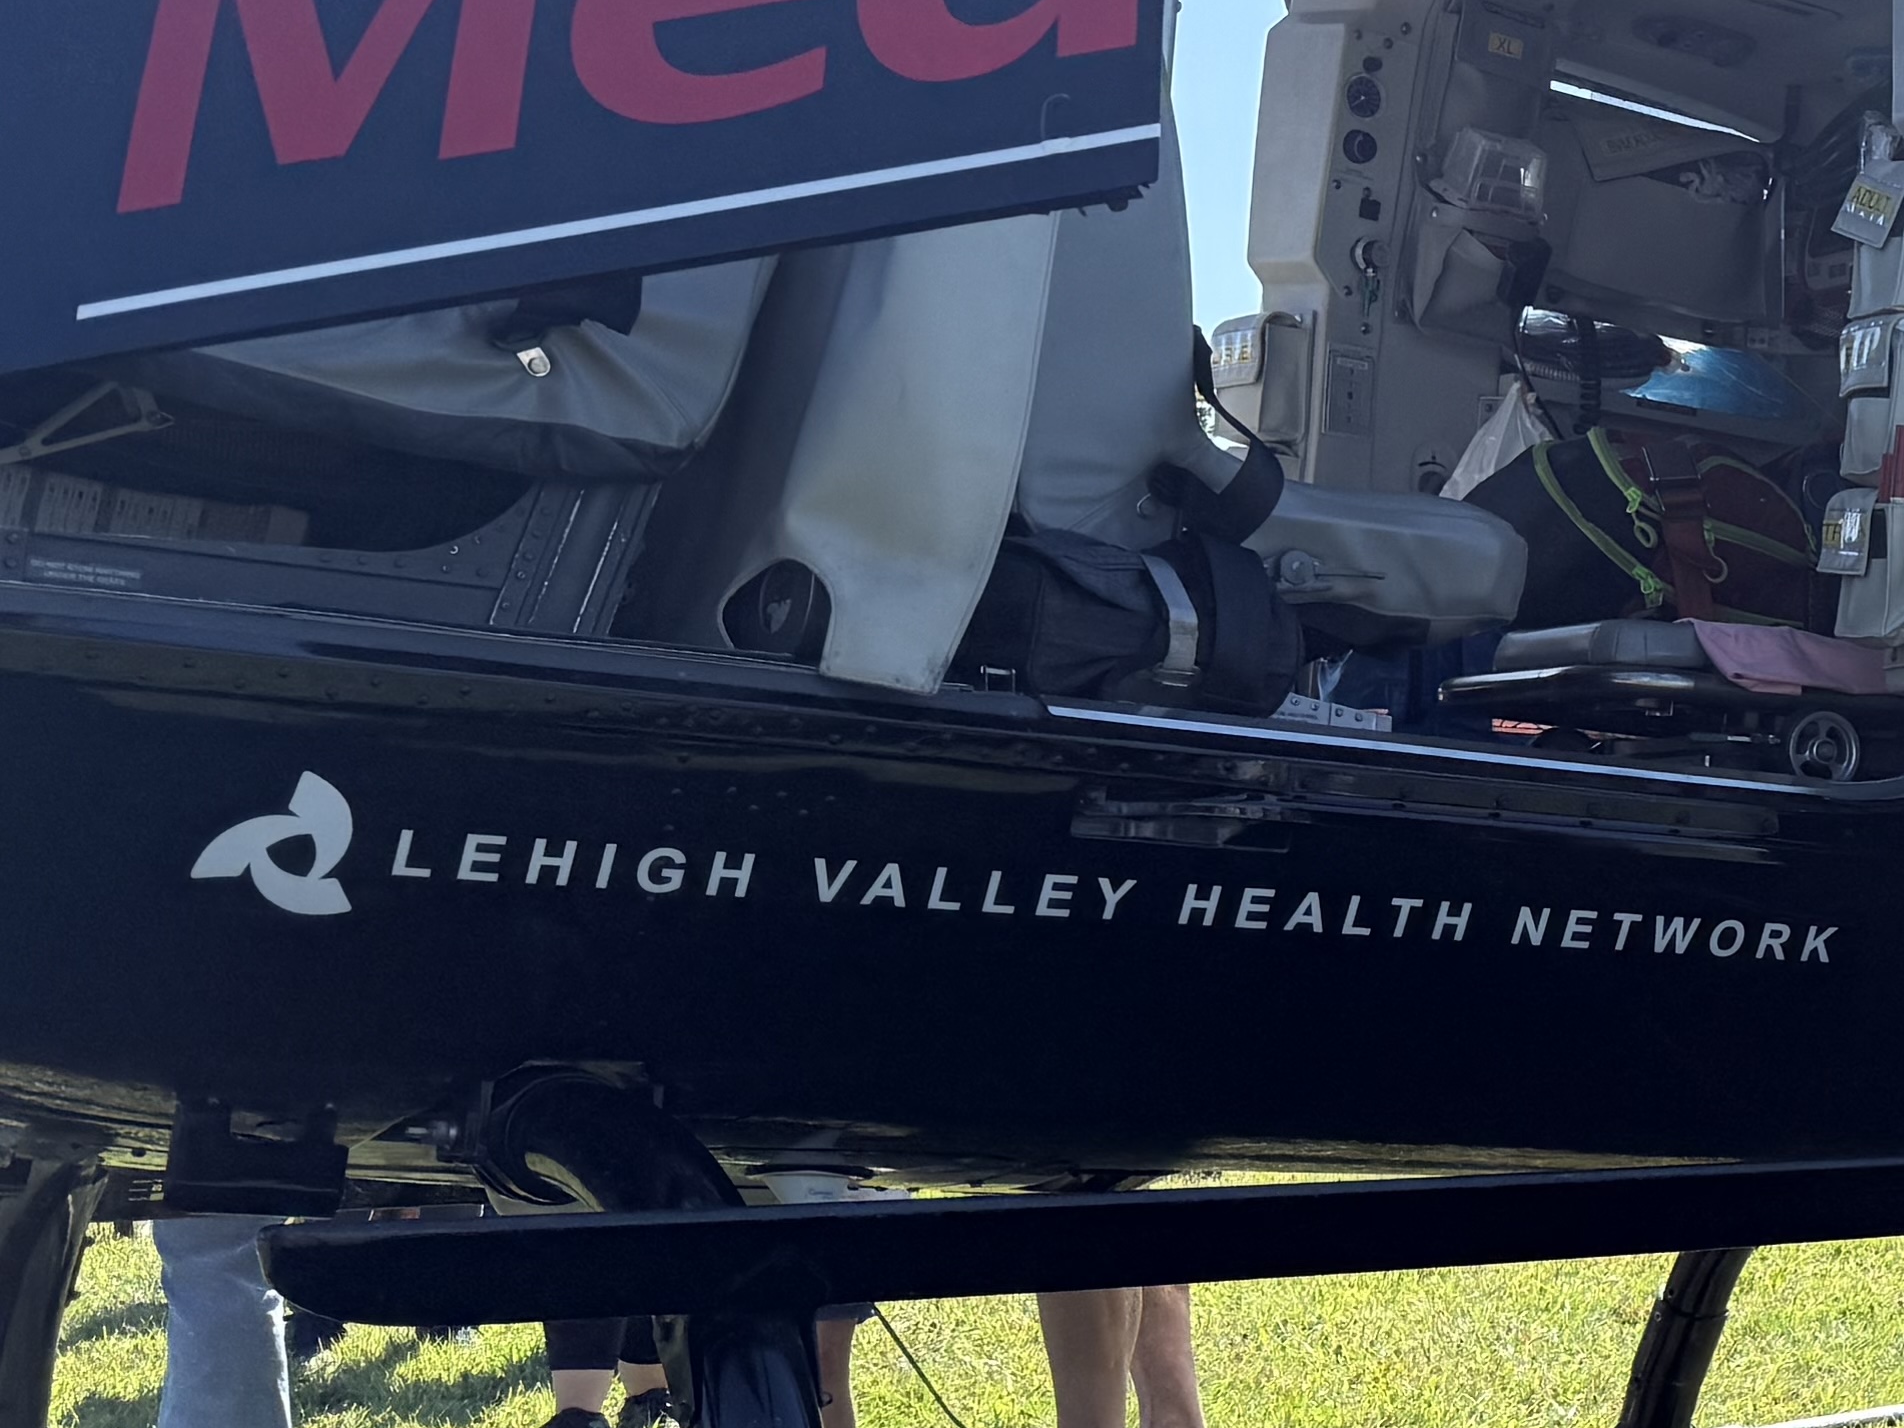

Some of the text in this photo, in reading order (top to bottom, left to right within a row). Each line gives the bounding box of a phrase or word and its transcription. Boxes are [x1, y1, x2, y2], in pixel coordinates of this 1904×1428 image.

[1497, 35, 1514, 56] XL
[391, 829, 1838, 963] LEHIGH VALLEY HEALTH NETWORK
